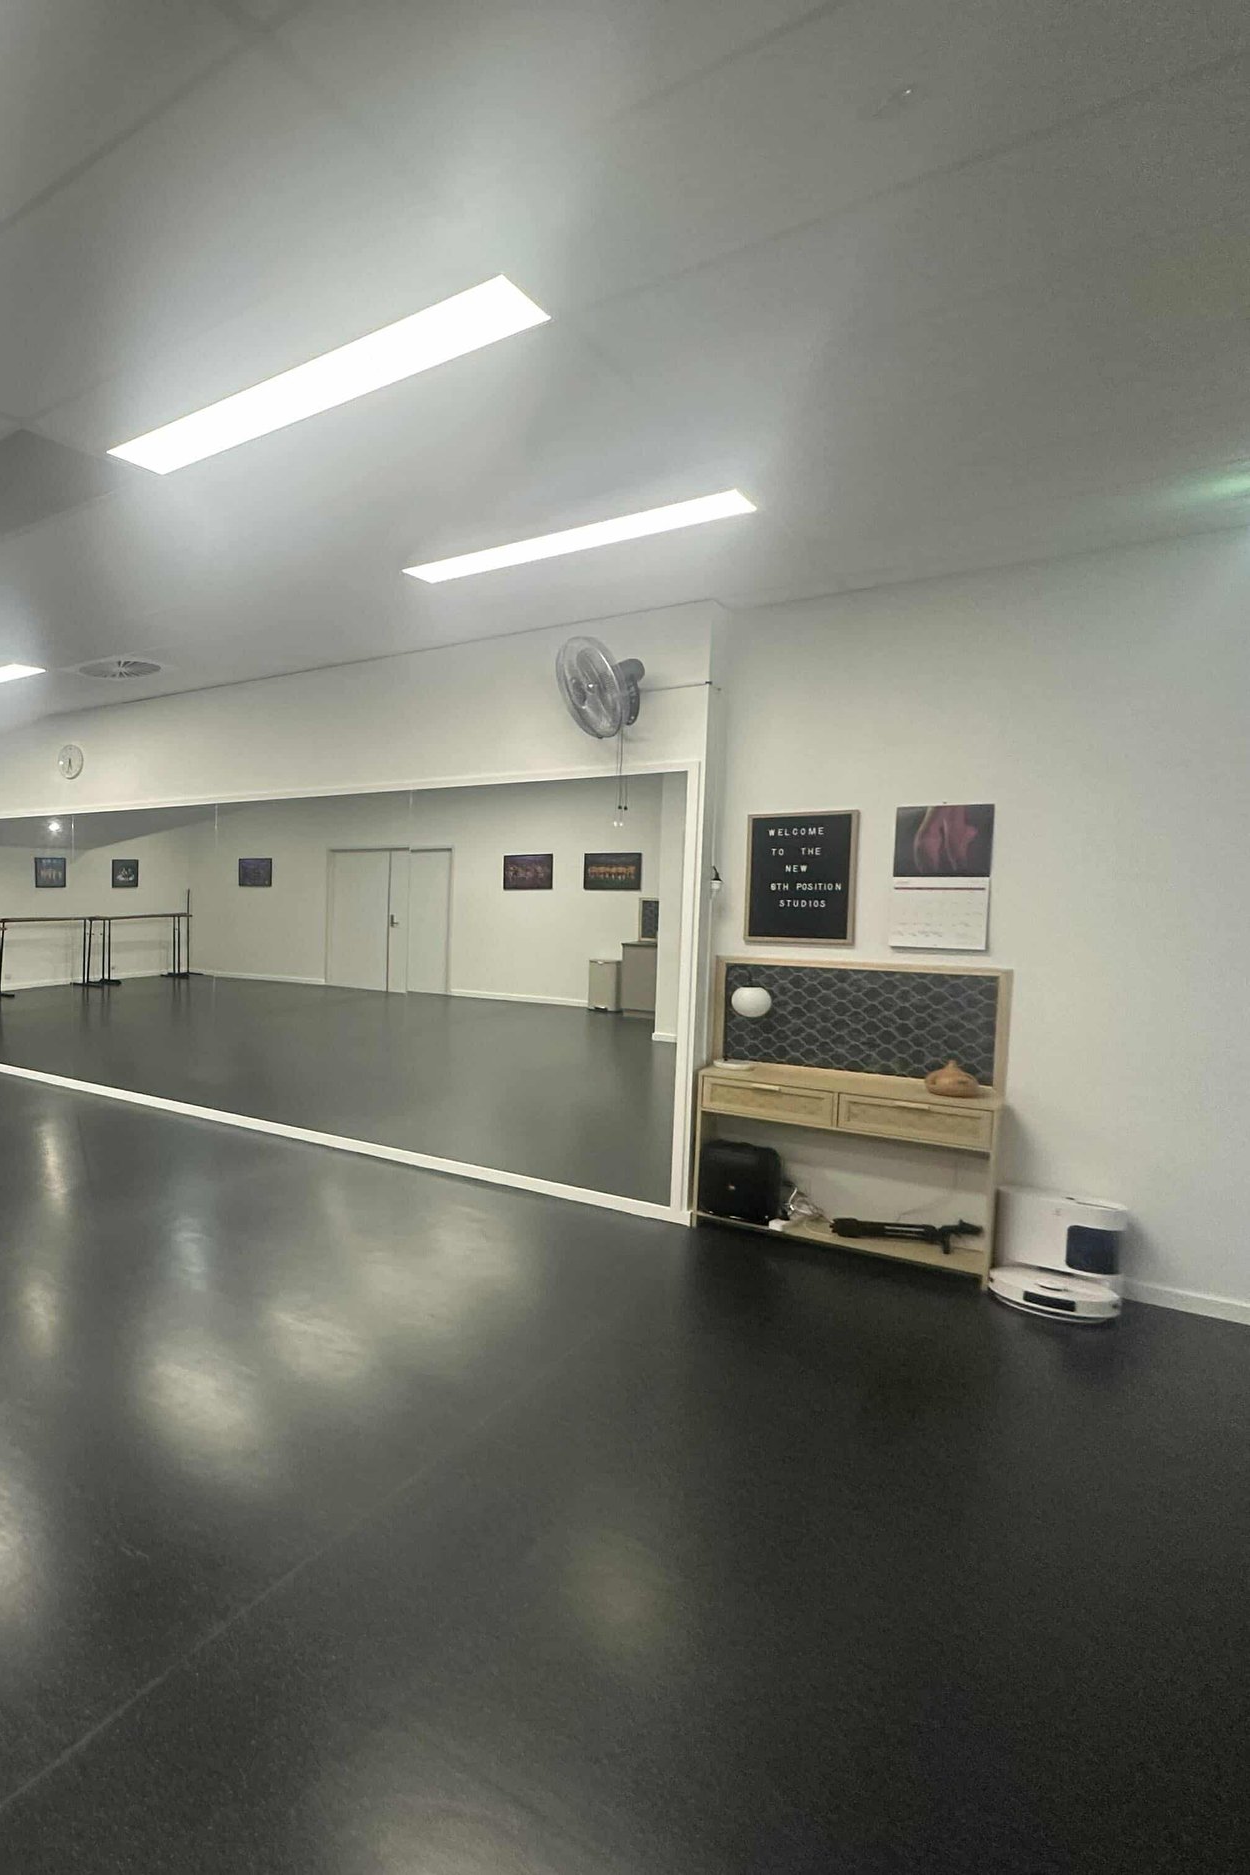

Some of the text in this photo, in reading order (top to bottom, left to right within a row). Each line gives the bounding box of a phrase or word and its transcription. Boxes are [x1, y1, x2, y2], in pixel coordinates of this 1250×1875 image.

[768, 826, 825, 837] WELCOME
[771, 847, 822, 856] TO THE
[785, 864, 808, 873] NEW
[796, 882, 842, 891] POSITION
[778, 899, 826, 908] STUDIOS
